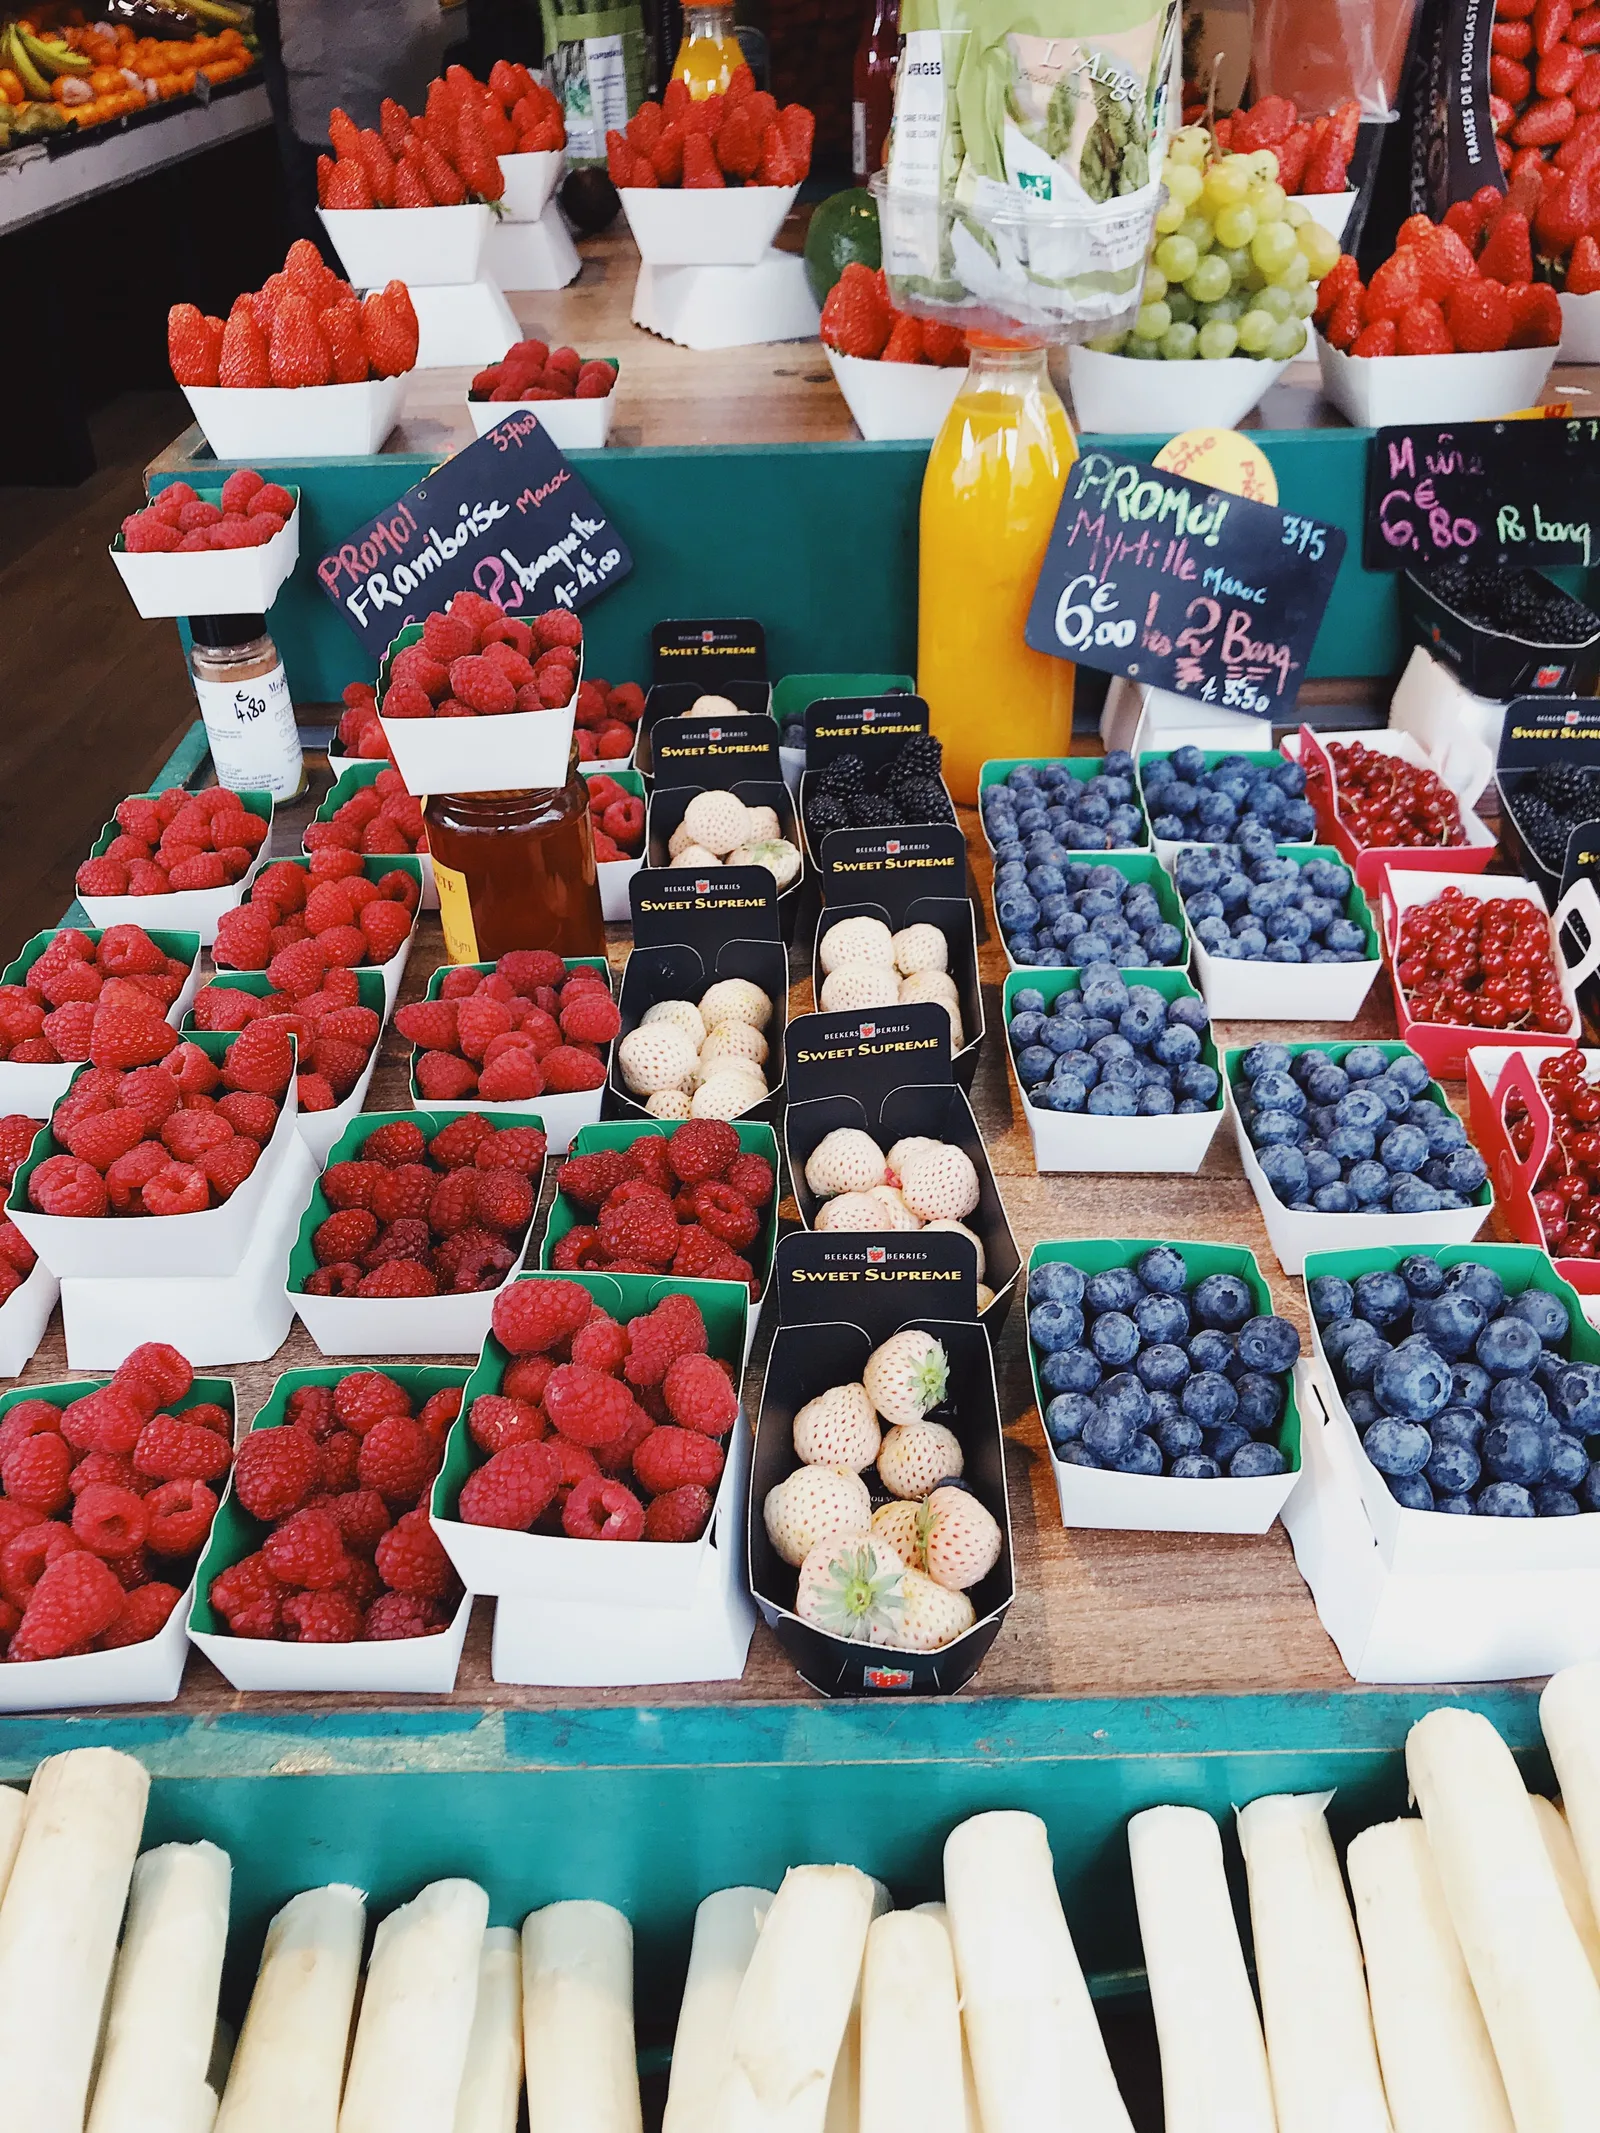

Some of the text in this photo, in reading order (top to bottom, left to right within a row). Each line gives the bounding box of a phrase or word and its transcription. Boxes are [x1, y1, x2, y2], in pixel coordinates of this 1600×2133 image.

[1460, 85, 1474, 106] DE
[1462, 107, 1482, 164] FRAISES
[1175, 597, 1222, 656] 2
[660, 645, 756, 656] SWEET SUPREME
[815, 723, 922, 738] SWEET SUPREME
[1511, 726, 1559, 740] SWEET
[661, 744, 770, 757] SWEET SUPREME
[832, 857, 955, 873] SWEET SUPREME
[640, 898, 767, 912] SWEET SUPREME
[824, 1024, 910, 1040] BEEKERS BERRIES
[797, 1038, 939, 1063] SWEET SUPREME
[824, 1252, 928, 1261] BEEKERS BERRIES
[791, 1268, 962, 1282] SWEET SUPREME
